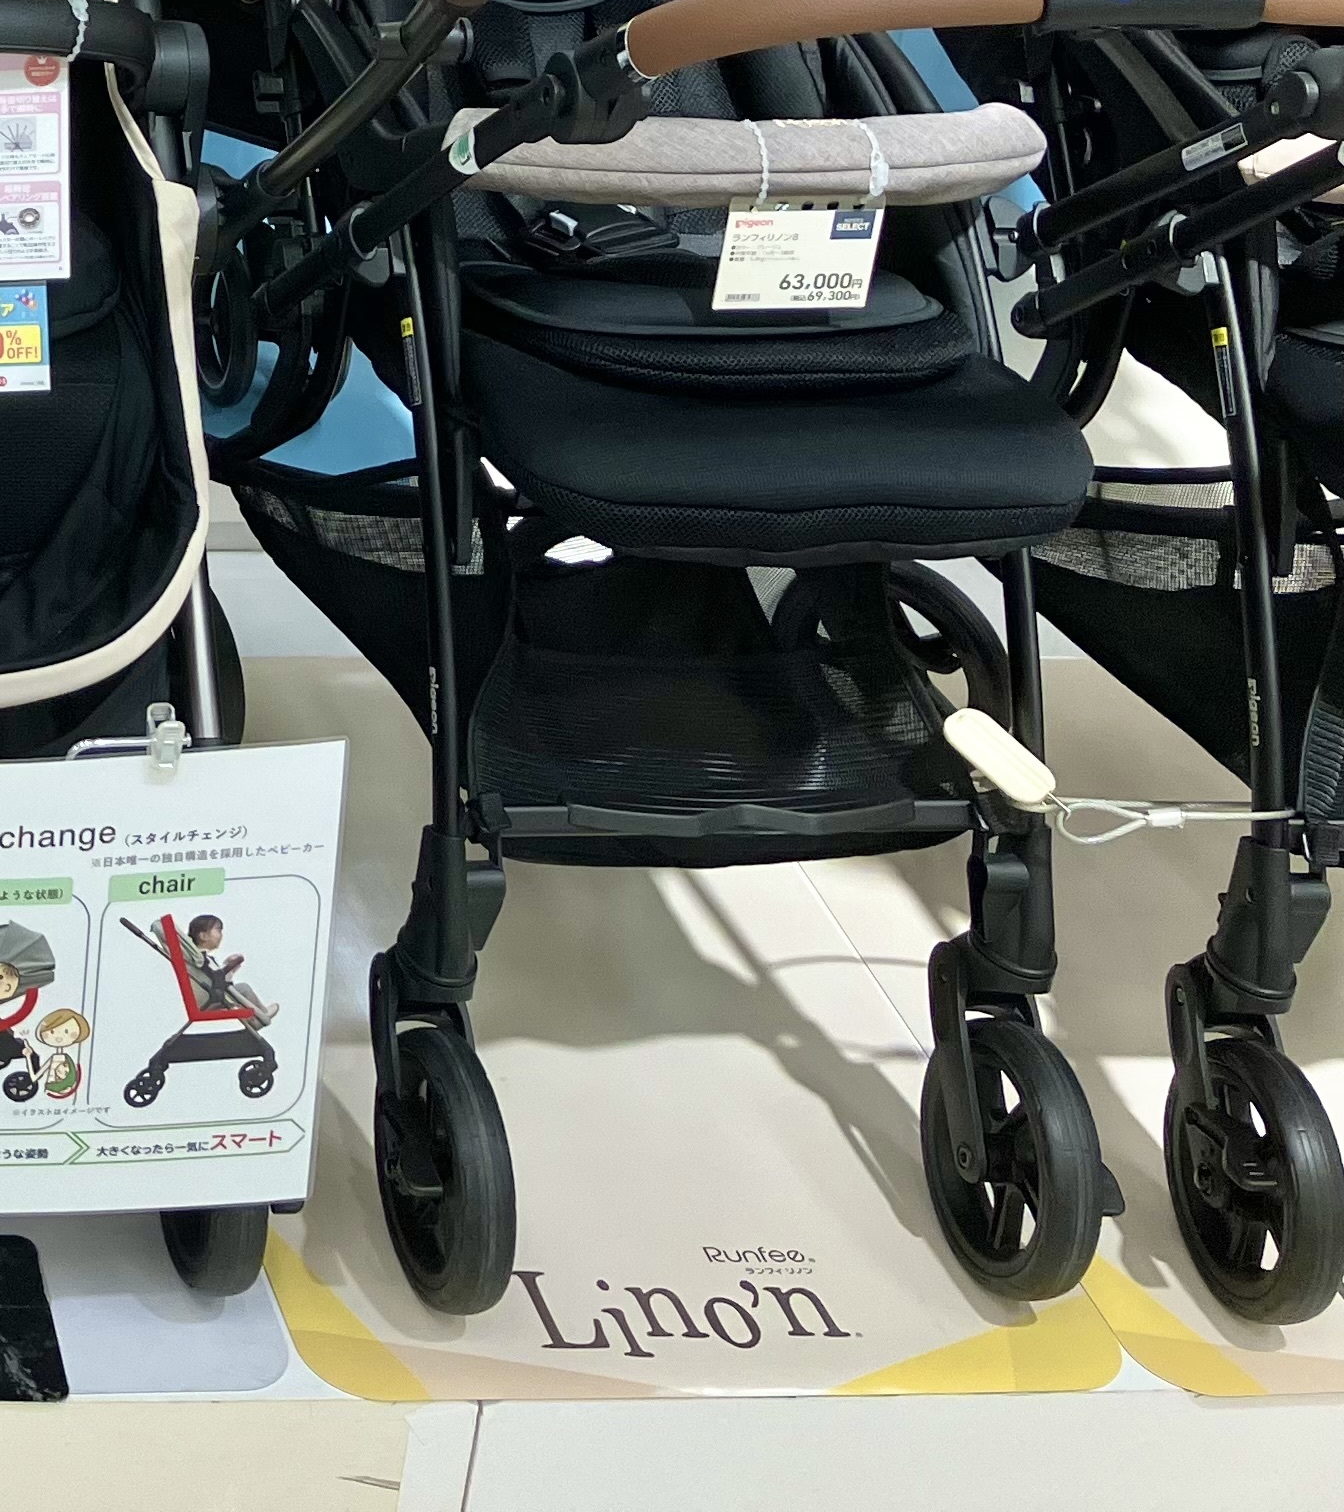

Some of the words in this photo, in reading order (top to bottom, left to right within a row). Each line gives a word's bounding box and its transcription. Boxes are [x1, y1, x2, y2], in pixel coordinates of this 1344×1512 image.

[735, 218, 773, 229] pigeon
[836, 222, 870, 231] SELECT
[779, 273, 863, 290] 63,000円
[429, 666, 439, 735] pigeon
[1248, 678, 1261, 746] pigeon
[125, 825, 248, 847] (スタイルチェンジ)
[139, 874, 195, 895] chair
[702, 1246, 807, 1263] Runfee
